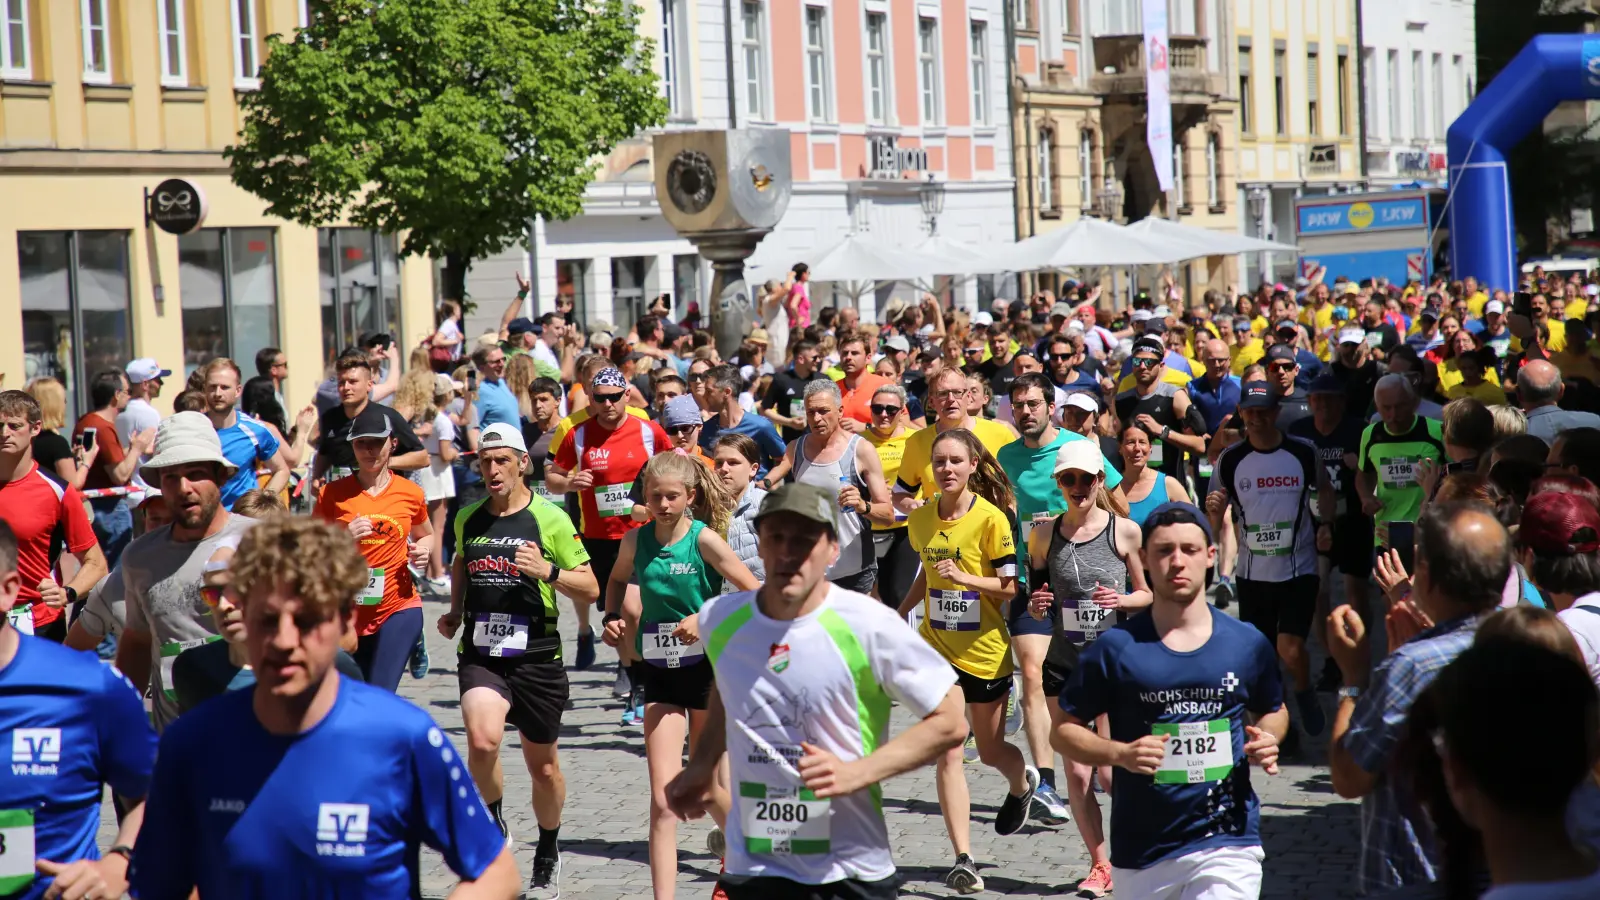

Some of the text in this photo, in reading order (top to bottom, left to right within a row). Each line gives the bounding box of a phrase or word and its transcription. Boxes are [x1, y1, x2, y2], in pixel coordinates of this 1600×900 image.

[1308, 211, 1342, 227] PKW
[1382, 206, 1416, 221] LKW
[589, 448, 610, 460] DAV
[1387, 464, 1413, 475] 2196
[1257, 476, 1300, 489] BOSCH
[604, 491, 630, 503] 2344
[1255, 530, 1282, 543] 2387
[923, 547, 949, 555] CITYLAUF
[467, 555, 521, 578] mabitz
[669, 562, 692, 575] TSV
[938, 600, 968, 613] 1466
[1074, 609, 1105, 622] 1478
[483, 623, 515, 638] 1434
[653, 634, 685, 648] 121
[1140, 688, 1225, 703] HOCHSCHULE
[1164, 702, 1223, 714] ANSBACH
[1171, 736, 1216, 755] 2182
[1187, 759, 1204, 767] Luis
[12, 764, 58, 776] VR-Bank
[756, 801, 808, 823] 2080
[767, 826, 797, 836] Oswin
[316, 843, 366, 857] VR-Bank
